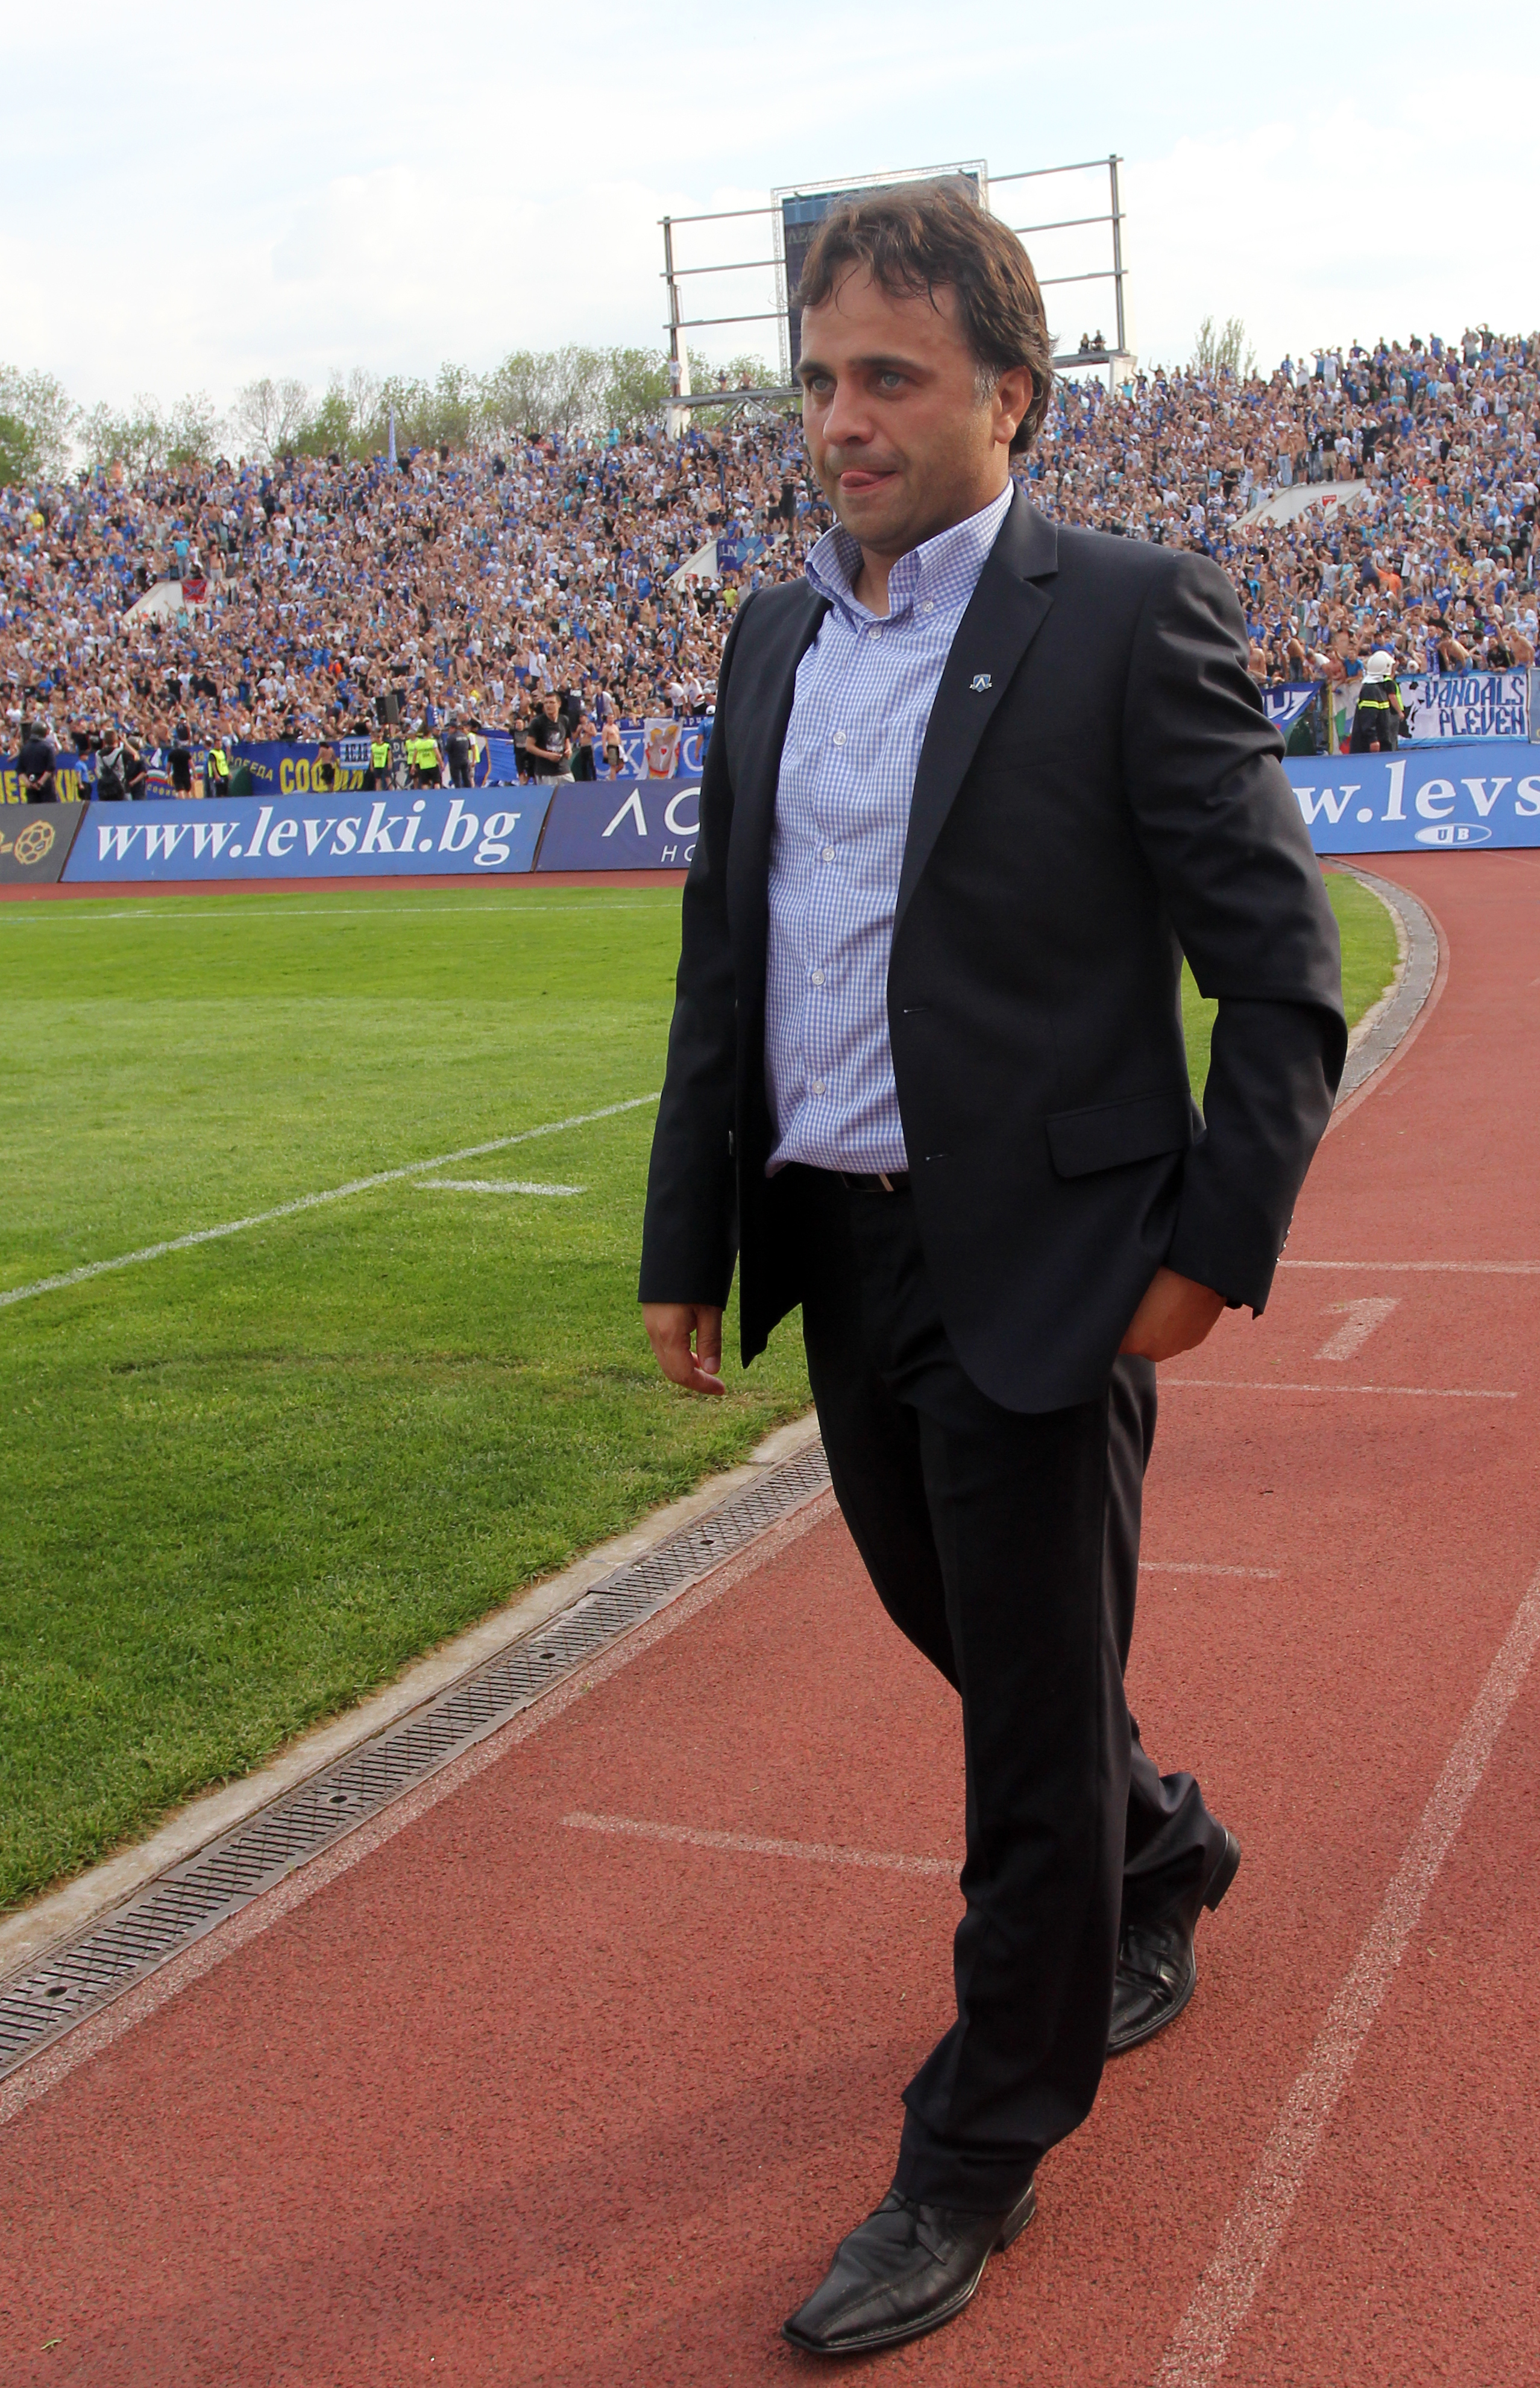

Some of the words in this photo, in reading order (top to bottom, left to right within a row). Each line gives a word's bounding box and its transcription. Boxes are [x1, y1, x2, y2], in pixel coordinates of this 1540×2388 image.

[1425, 677, 1524, 708] VANDALS
[1439, 707, 1526, 736] PLEVEN
[98, 799, 521, 866] www.levski.bg
